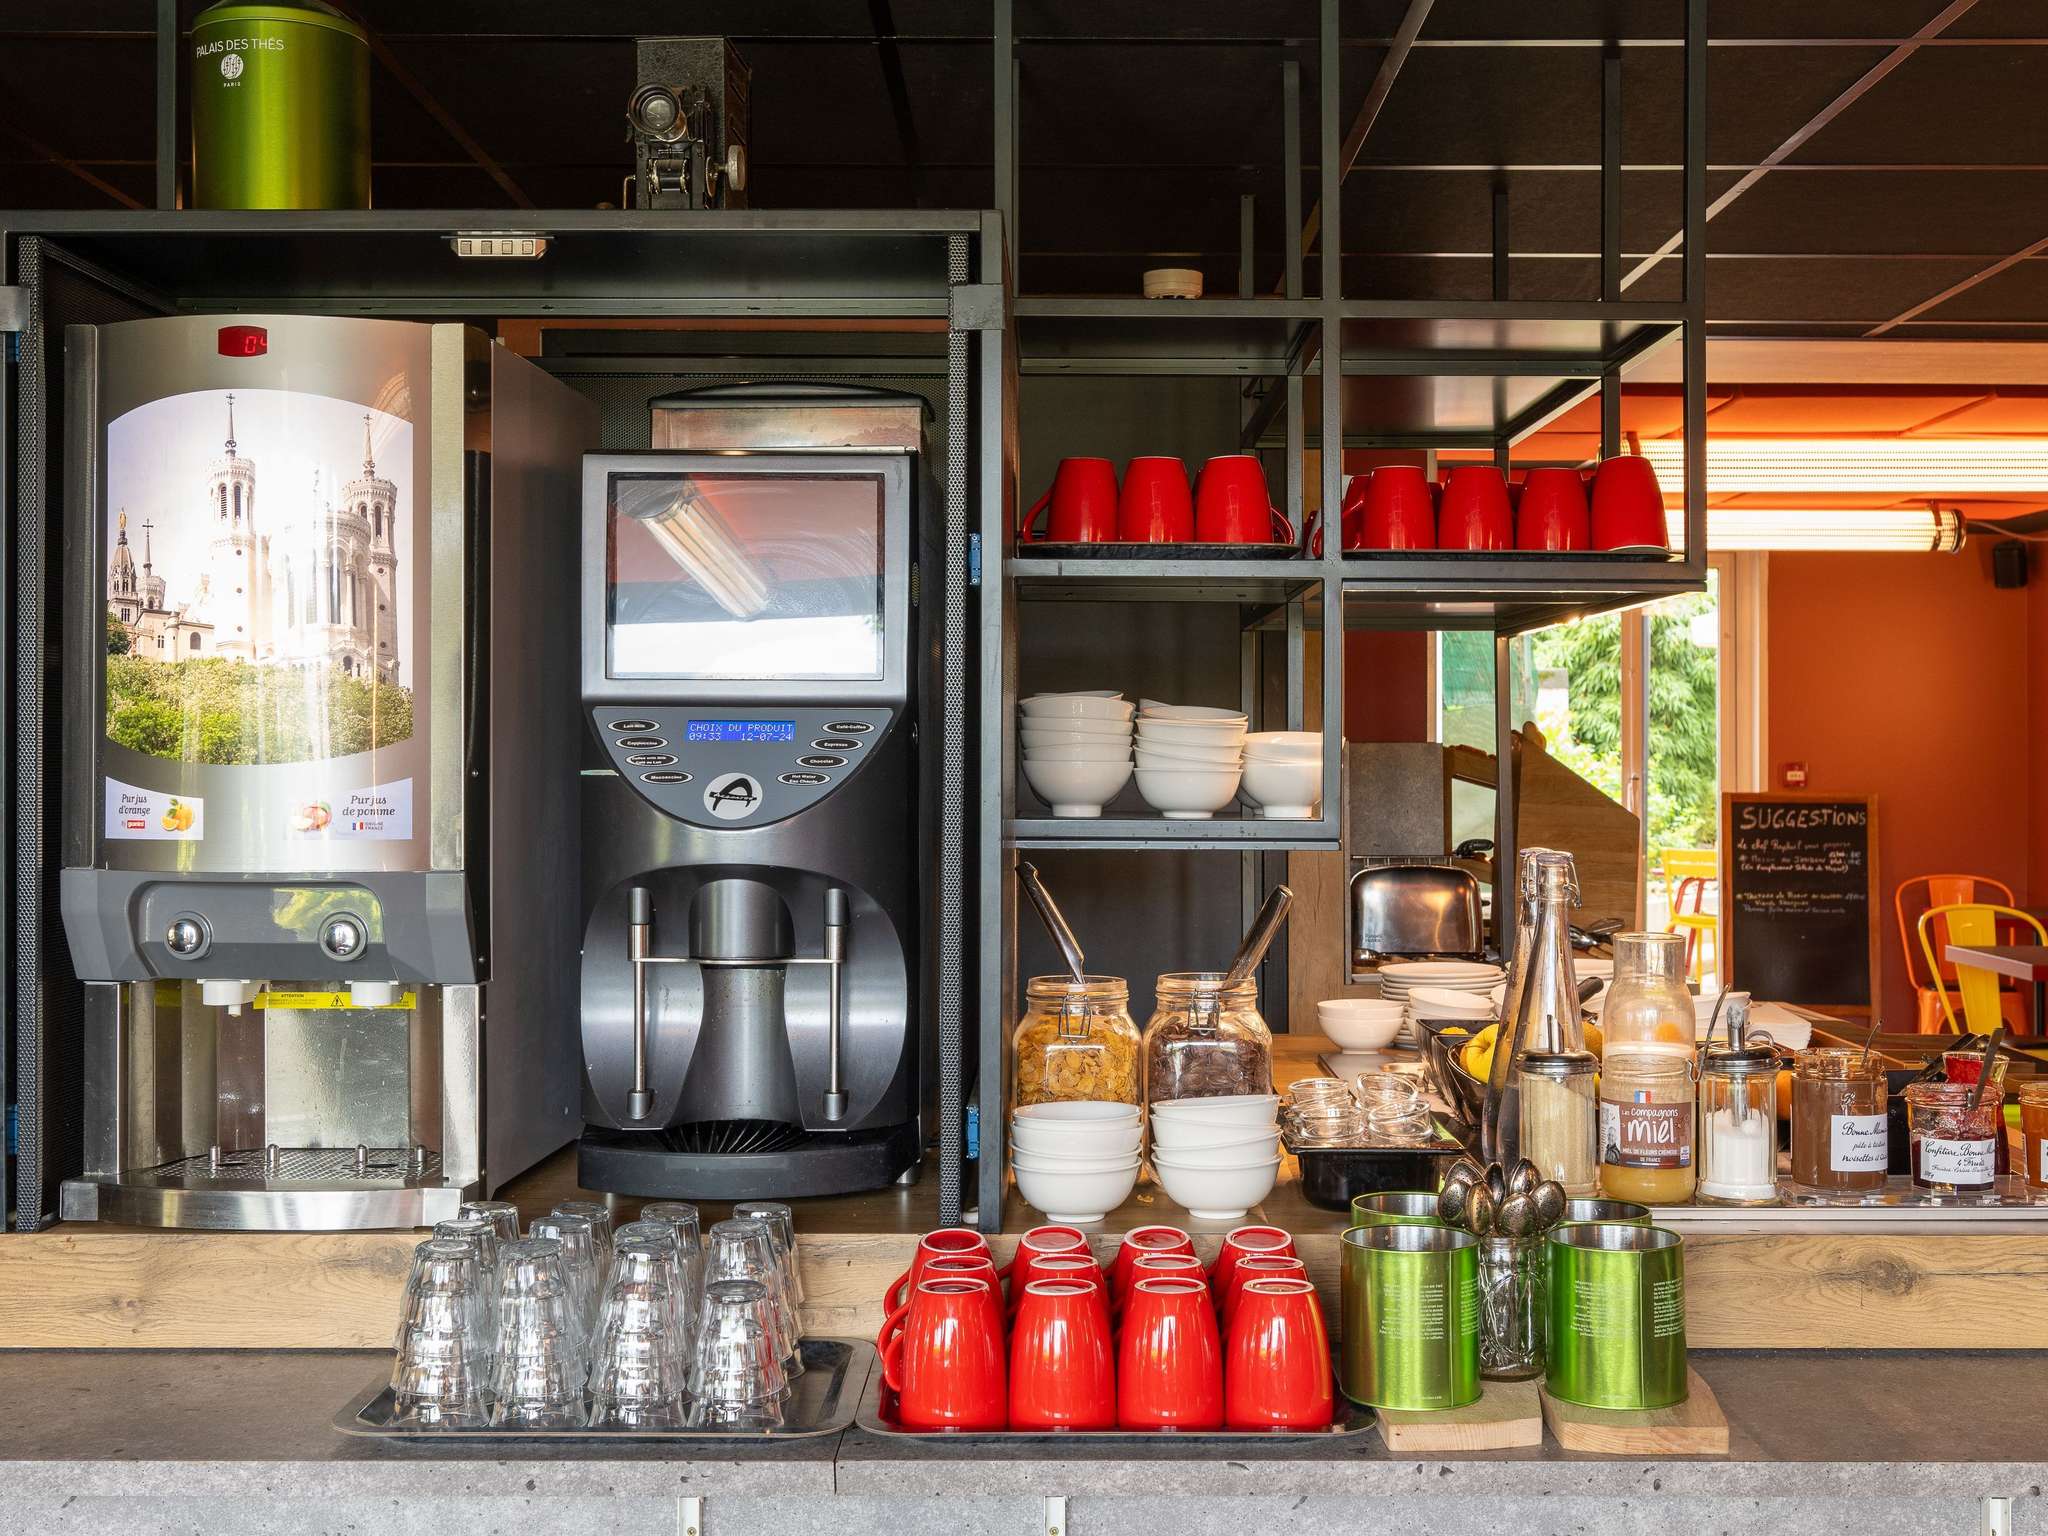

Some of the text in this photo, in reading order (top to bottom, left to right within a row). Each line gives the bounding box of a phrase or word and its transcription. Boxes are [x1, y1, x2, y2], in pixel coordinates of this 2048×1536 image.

[196, 37, 285, 58] PALAIS DES THÉS
[690, 723, 794, 732] CHOIX DU PRODUIT
[689, 732, 793, 741] 09:33 12-07-24
[121, 793, 147, 805] Pur jus
[350, 795, 387, 806] Pur jus
[118, 805, 151, 816] d'orange
[342, 807, 396, 818] de pomme
[1630, 1107, 1679, 1120] Compagnons
[1841, 1121, 1869, 1136] Bonne
[1925, 1140, 1959, 1157] Confiture
[1959, 1142, 1985, 1156] Bonne
